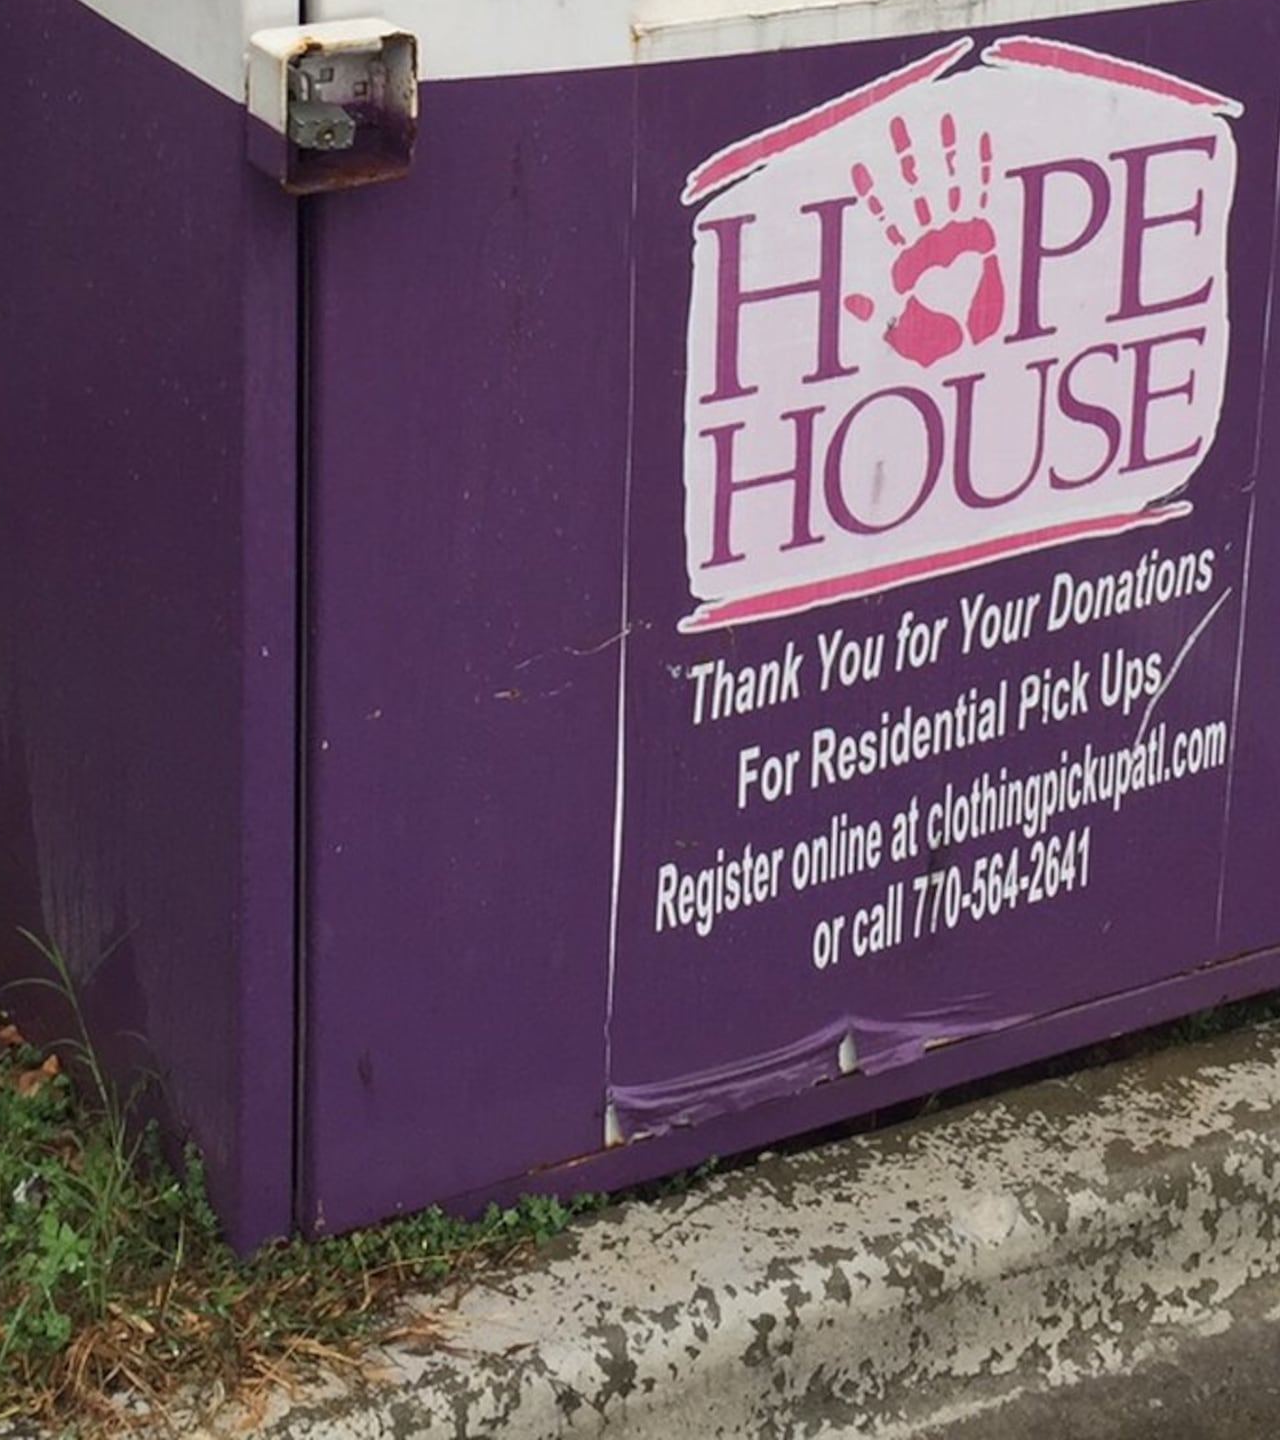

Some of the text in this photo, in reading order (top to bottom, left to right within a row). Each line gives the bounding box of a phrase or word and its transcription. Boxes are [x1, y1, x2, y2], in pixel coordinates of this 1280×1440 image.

[699, 329, 1207, 570] HOUSE
[687, 546, 1215, 724] Thank You for Your Donations
[737, 649, 1163, 809] For Residential Pick Ups
[654, 716, 1228, 937] Register online at clothingpickupatl.com
[813, 825, 1092, 970] or call 770-564-2641
